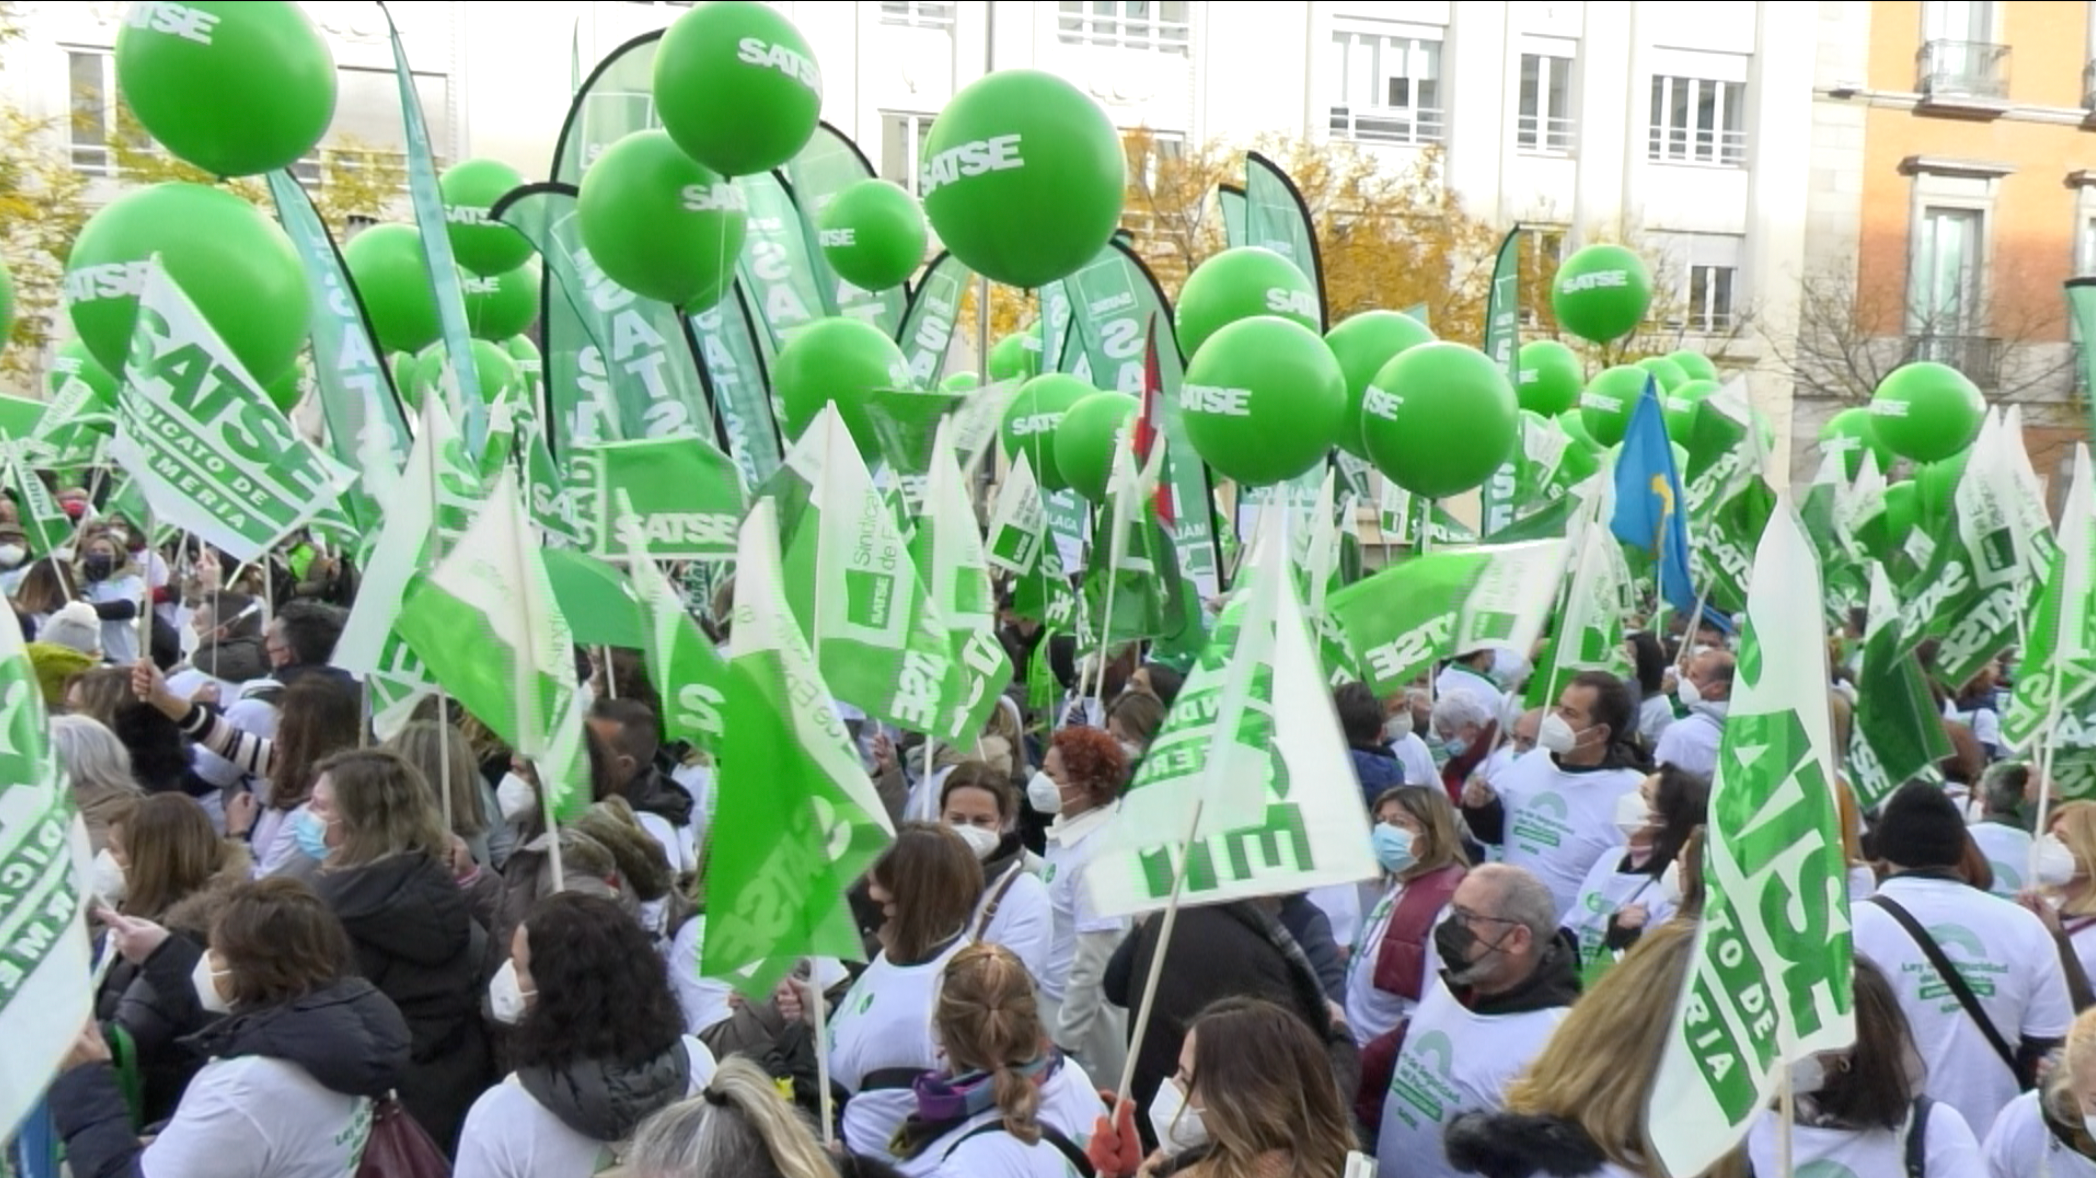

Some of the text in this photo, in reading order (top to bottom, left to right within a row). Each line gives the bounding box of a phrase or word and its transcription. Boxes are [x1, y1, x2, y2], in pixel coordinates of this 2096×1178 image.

[1562, 269, 1628, 294] SATSE
[231, 473, 269, 508] DE
[614, 511, 740, 550] SATSE
[1738, 980, 1778, 1043] DE
